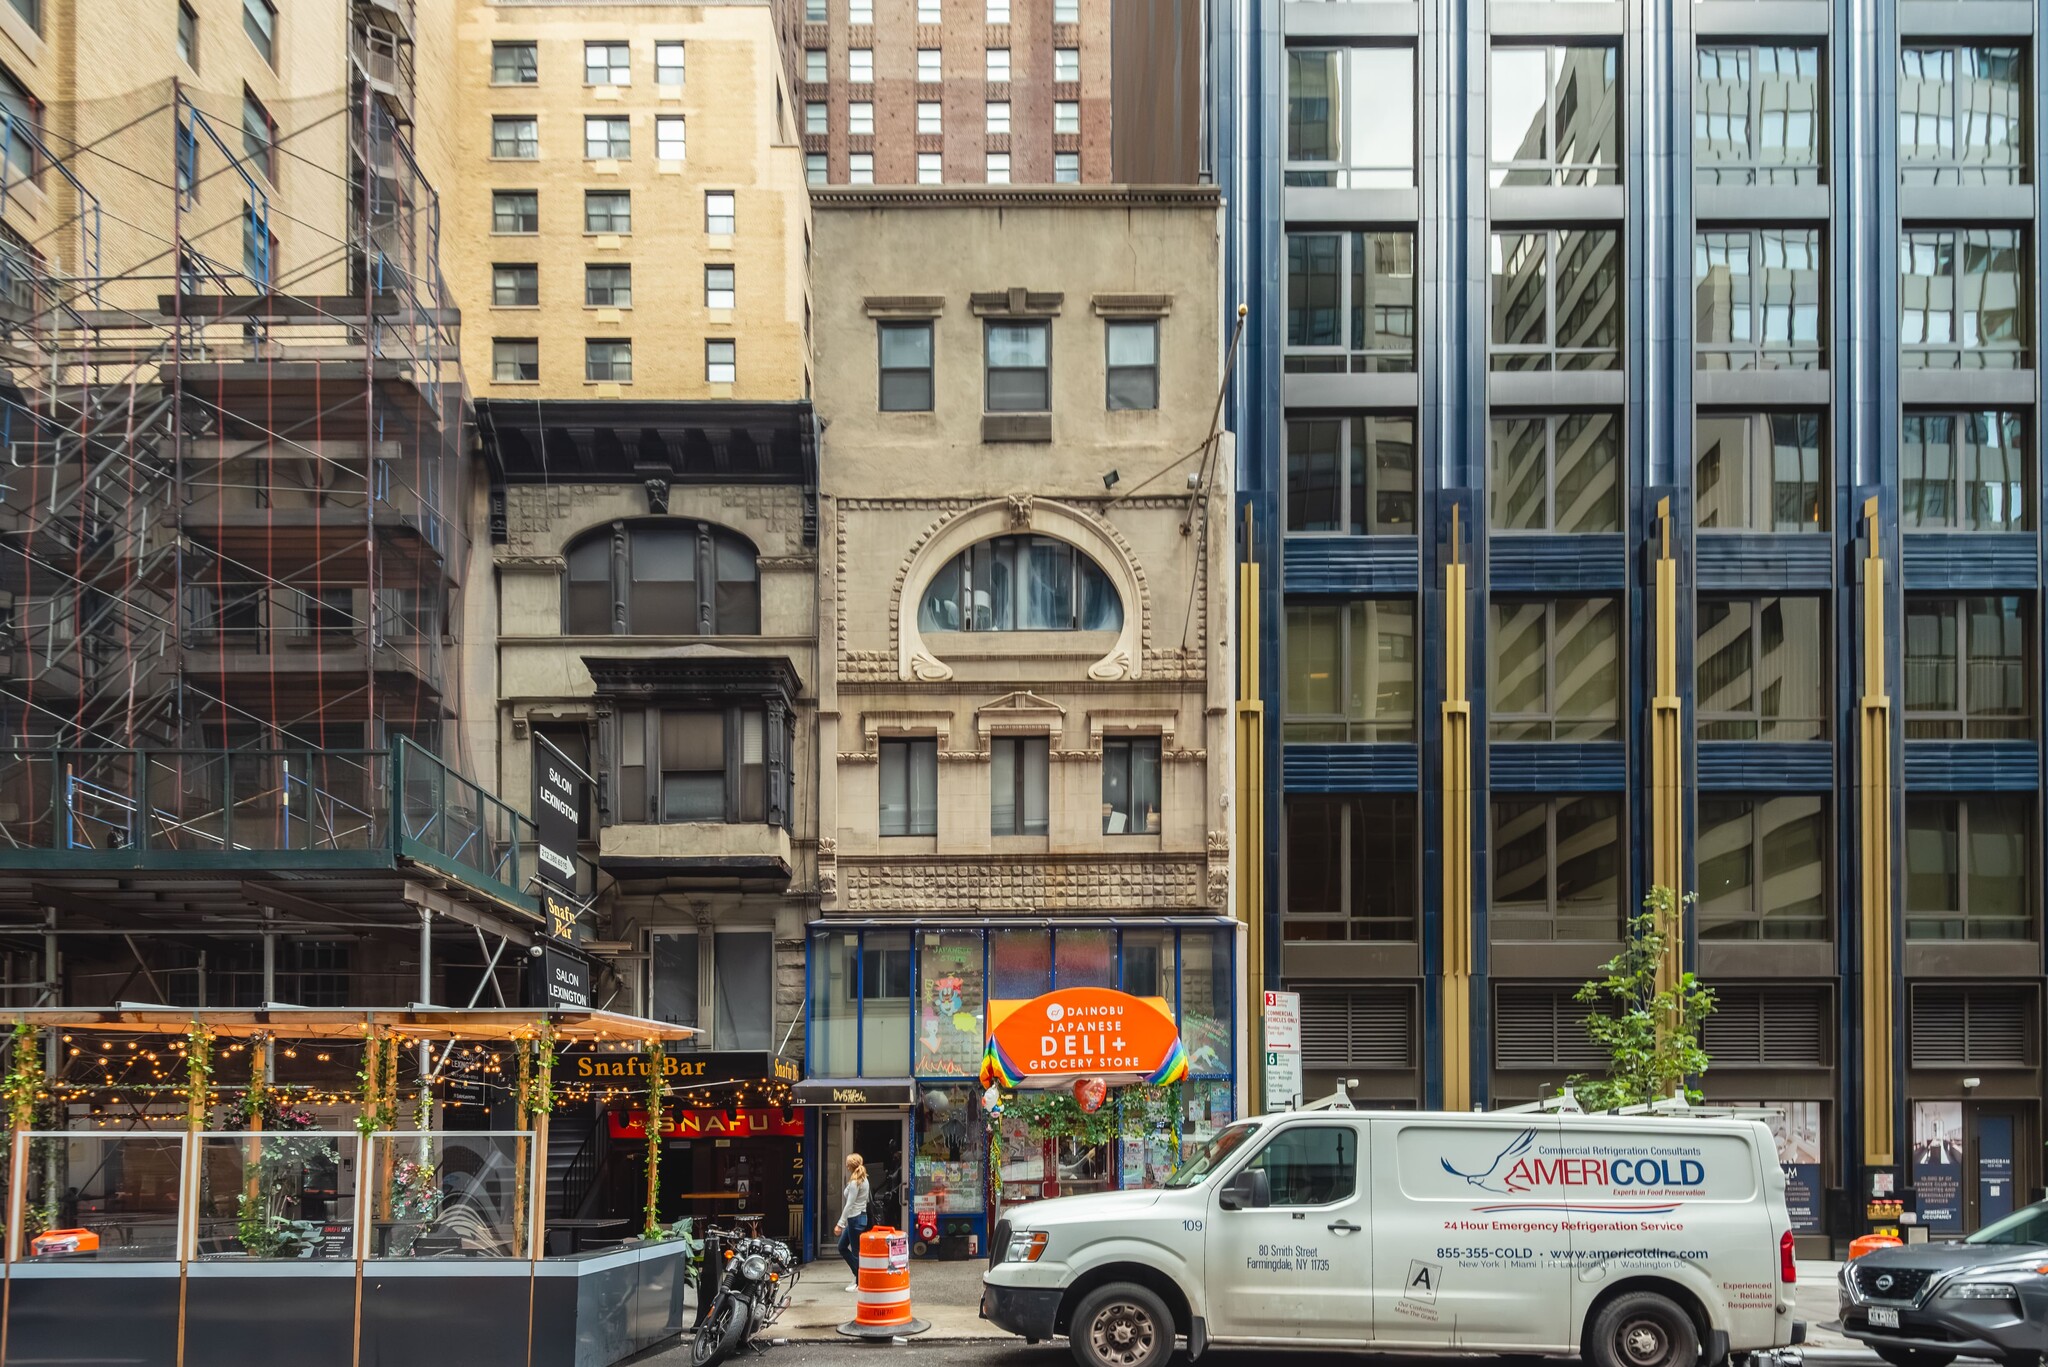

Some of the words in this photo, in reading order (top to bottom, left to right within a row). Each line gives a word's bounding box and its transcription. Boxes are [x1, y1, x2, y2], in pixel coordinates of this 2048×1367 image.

[549, 767, 572, 796] SALON
[540, 786, 578, 824] LEXINGTON
[547, 896, 577, 925] Snafu
[554, 917, 573, 940] Bar
[555, 968, 579, 987] SALON
[549, 983, 587, 1007] LEXINGTON
[1268, 993, 1274, 1006] 3
[1067, 1006, 1124, 1017] DAINOBU
[1048, 1021, 1121, 1033] JAPANESE
[1029, 1058, 1093, 1070] GROCERY
[1099, 1057, 1139, 1068] STORE
[1269, 1053, 1275, 1065] 6
[578, 1057, 652, 1077] Snafu
[663, 1057, 706, 1076] Bar
[774, 1058, 792, 1080] Snafu
[658, 1115, 768, 1132] SNAFU
[1538, 1145, 1591, 1156] Commercial
[1592, 1145, 1649, 1157] Refrigeration
[1650, 1146, 1701, 1156] Consultants
[1504, 1157, 1705, 1188] AMERICOLD
[1612, 1188, 1638, 1197] Experts
[1182, 1219, 1203, 1232] 109
[1443, 1221, 1458, 1230] 24
[1460, 1221, 1489, 1231] Hour
[1492, 1221, 1558, 1233] Emergency
[1561, 1221, 1638, 1233] Refrigeration
[1640, 1221, 1684, 1231] Service
[1258, 1244, 1269, 1256] 80
[1271, 1245, 1293, 1257] Smith
[1295, 1245, 1318, 1258] Street
[1436, 1248, 1533, 1259] 855-355-COLD
[1550, 1248, 1709, 1260] www.americoldinc.com
[1247, 1257, 1293, 1273] Farmingdale,
[1296, 1259, 1307, 1270] NY
[1311, 1259, 1329, 1271] 11735
[1458, 1260, 1479, 1269] New
[1480, 1260, 1500, 1268] York
[1510, 1260, 1537, 1269] Miami
[1620, 1260, 1673, 1270] Washington
[1673, 1261, 1687, 1269] DC
[1411, 1266, 1431, 1290] A
[1723, 1282, 1772, 1290] Experienced
[1394, 1306, 1410, 1315] Make
[1410, 1310, 1420, 1318] The
[1397, 1300, 1409, 1309] Our
[1409, 1303, 1438, 1315] Customers
[1727, 1301, 1773, 1310] Responsive
